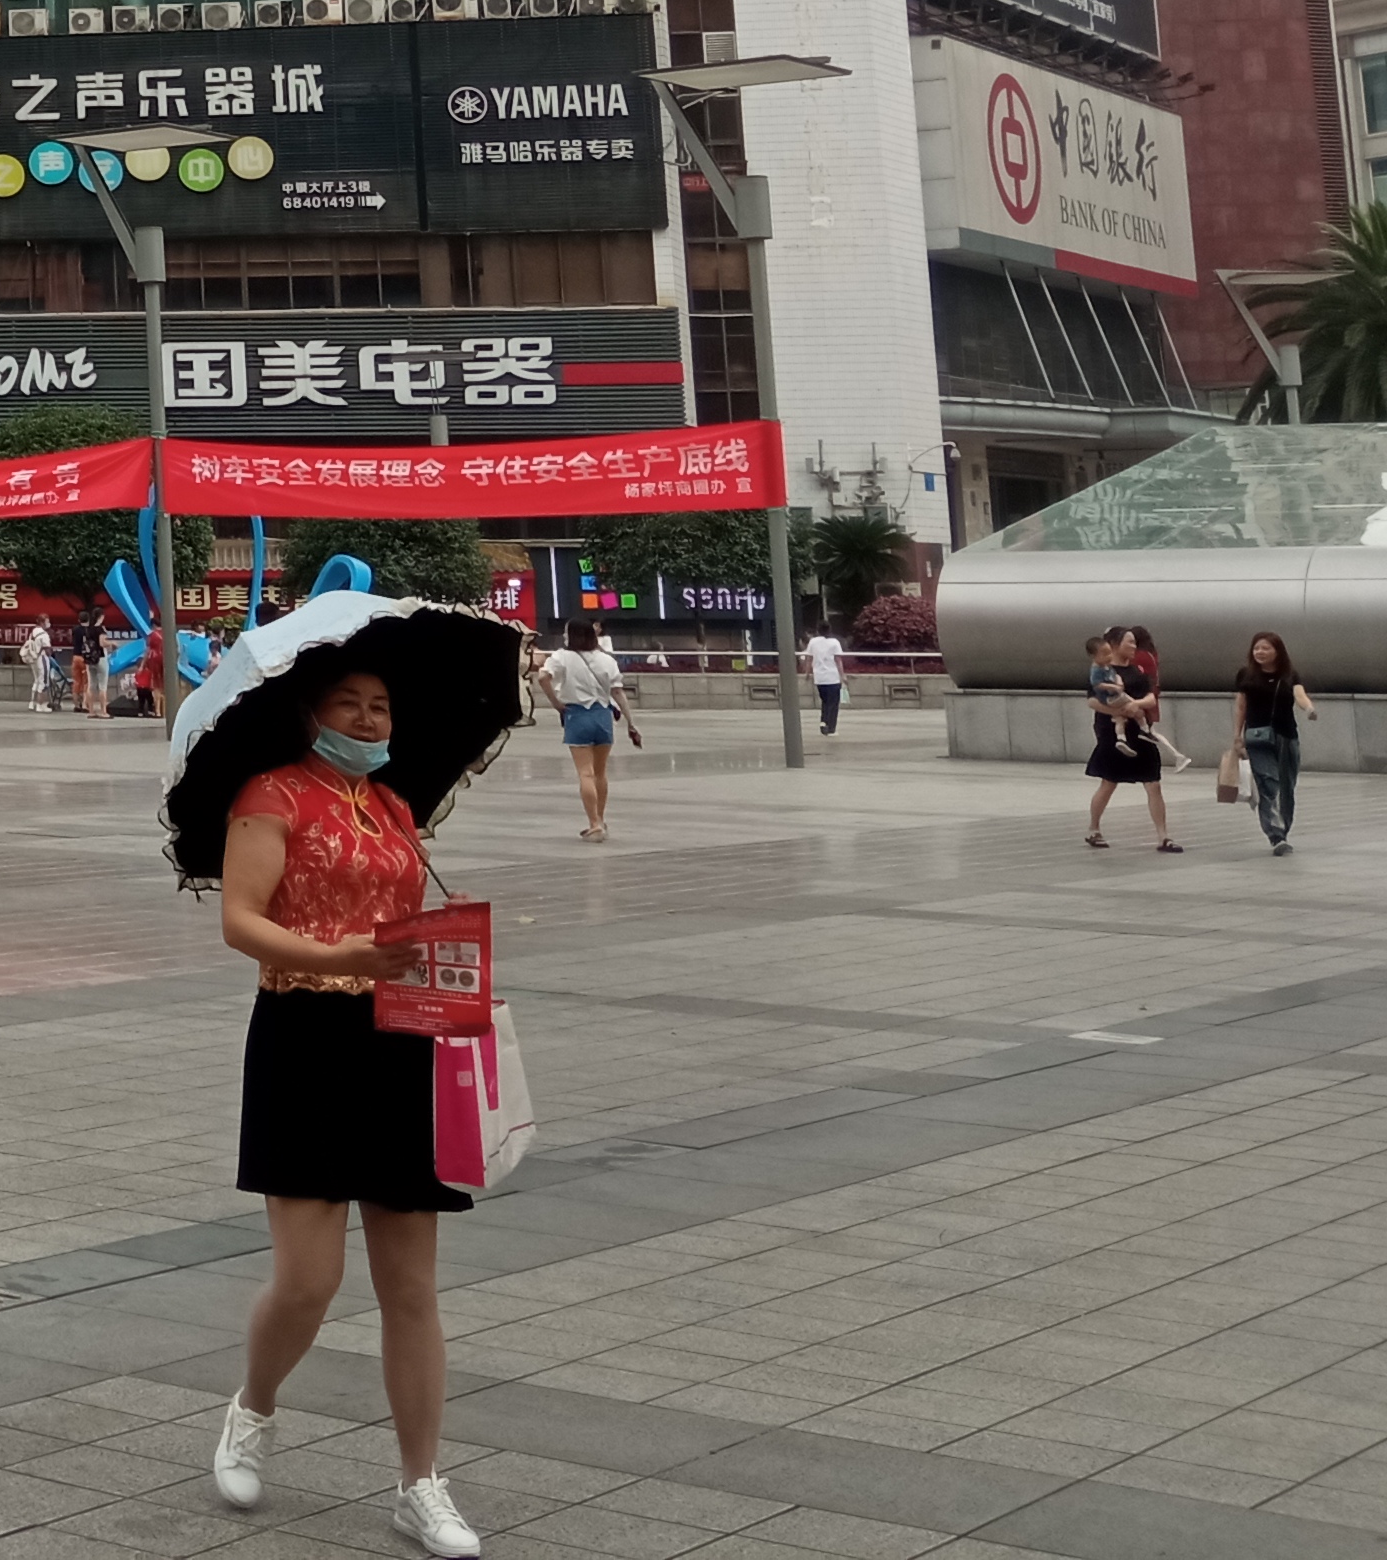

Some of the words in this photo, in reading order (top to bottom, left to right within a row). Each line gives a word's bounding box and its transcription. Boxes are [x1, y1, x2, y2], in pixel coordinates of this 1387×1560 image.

[490, 83, 630, 121] YAMAHA
[459, 138, 636, 165] 雅马哈乐器专卖
[282, 195, 355, 209] 68401419
[1059, 194, 1100, 233] BANK
[1101, 208, 1119, 237] OF
[1122, 213, 1167, 249] CHINA
[161, 336, 557, 407] 国美电器
[191, 453, 447, 488] 树牢安全发展理念
[459, 438, 750, 486] 守住安全生产底线
[624, 478, 727, 499] 杨家坪商圈办
[735, 477, 753, 494] 宣
